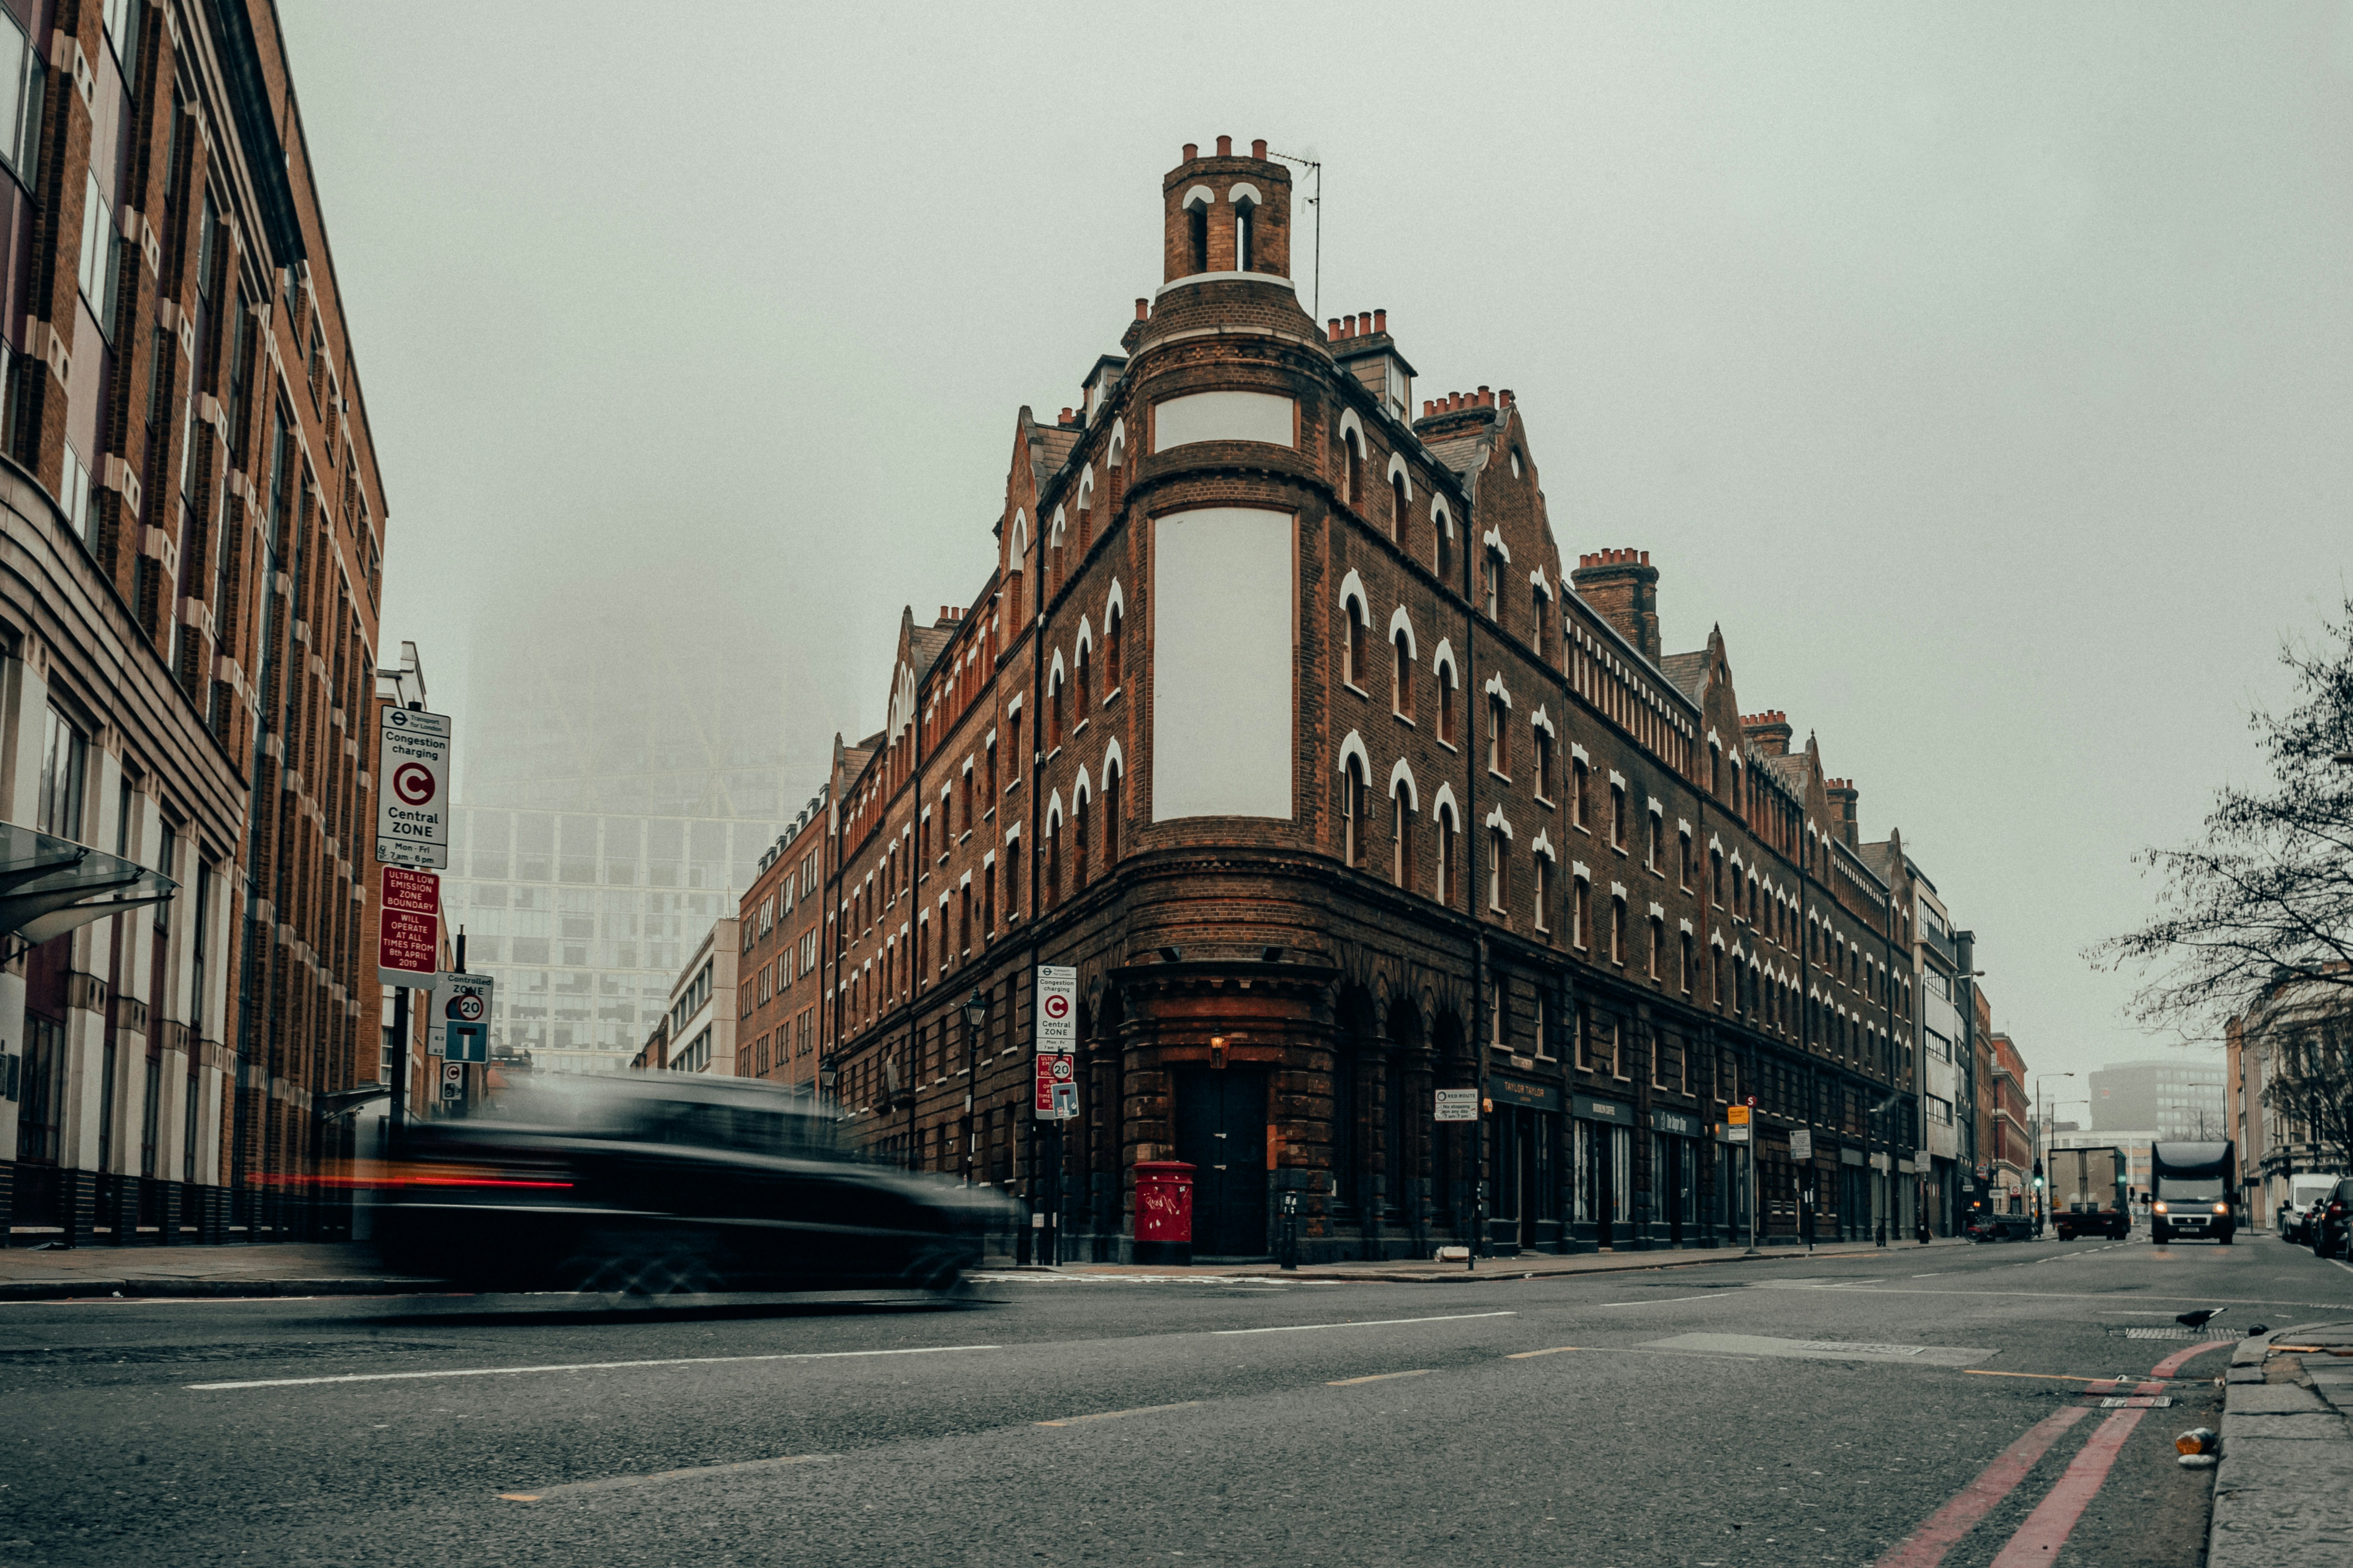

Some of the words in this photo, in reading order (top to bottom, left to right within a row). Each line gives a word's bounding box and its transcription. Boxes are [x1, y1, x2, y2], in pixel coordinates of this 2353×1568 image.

[411, 715, 440, 725] Transport
[420, 724, 442, 732] London
[386, 731, 445, 749] Congestion
[392, 745, 438, 761] charging
[389, 807, 438, 823] Central
[393, 822, 433, 837] ZONE
[395, 843, 412, 851] Mon
[389, 871, 414, 881] ULTRA
[417, 875, 434, 884] LOW
[391, 880, 432, 893] EMISSION
[400, 890, 422, 900] ZONE
[388, 897, 434, 910] BOUNDARY
[401, 914, 419, 923] WILL
[391, 921, 427, 933] OPERATE
[408, 933, 422, 942] ALL
[384, 938, 408, 948] TIMES
[411, 943, 434, 952] FROM
[405, 951, 427, 960] APRIL
[399, 959, 417, 967] 2019
[448, 975, 491, 985] Controlled
[462, 1002, 479, 1013] 20
[1055, 1065, 1069, 1074] 20
[1504, 1082, 1524, 1093] TAYLOR
[1525, 1086, 1544, 1097] TAYLOR
[1748, 1097, 1753, 1105] S
